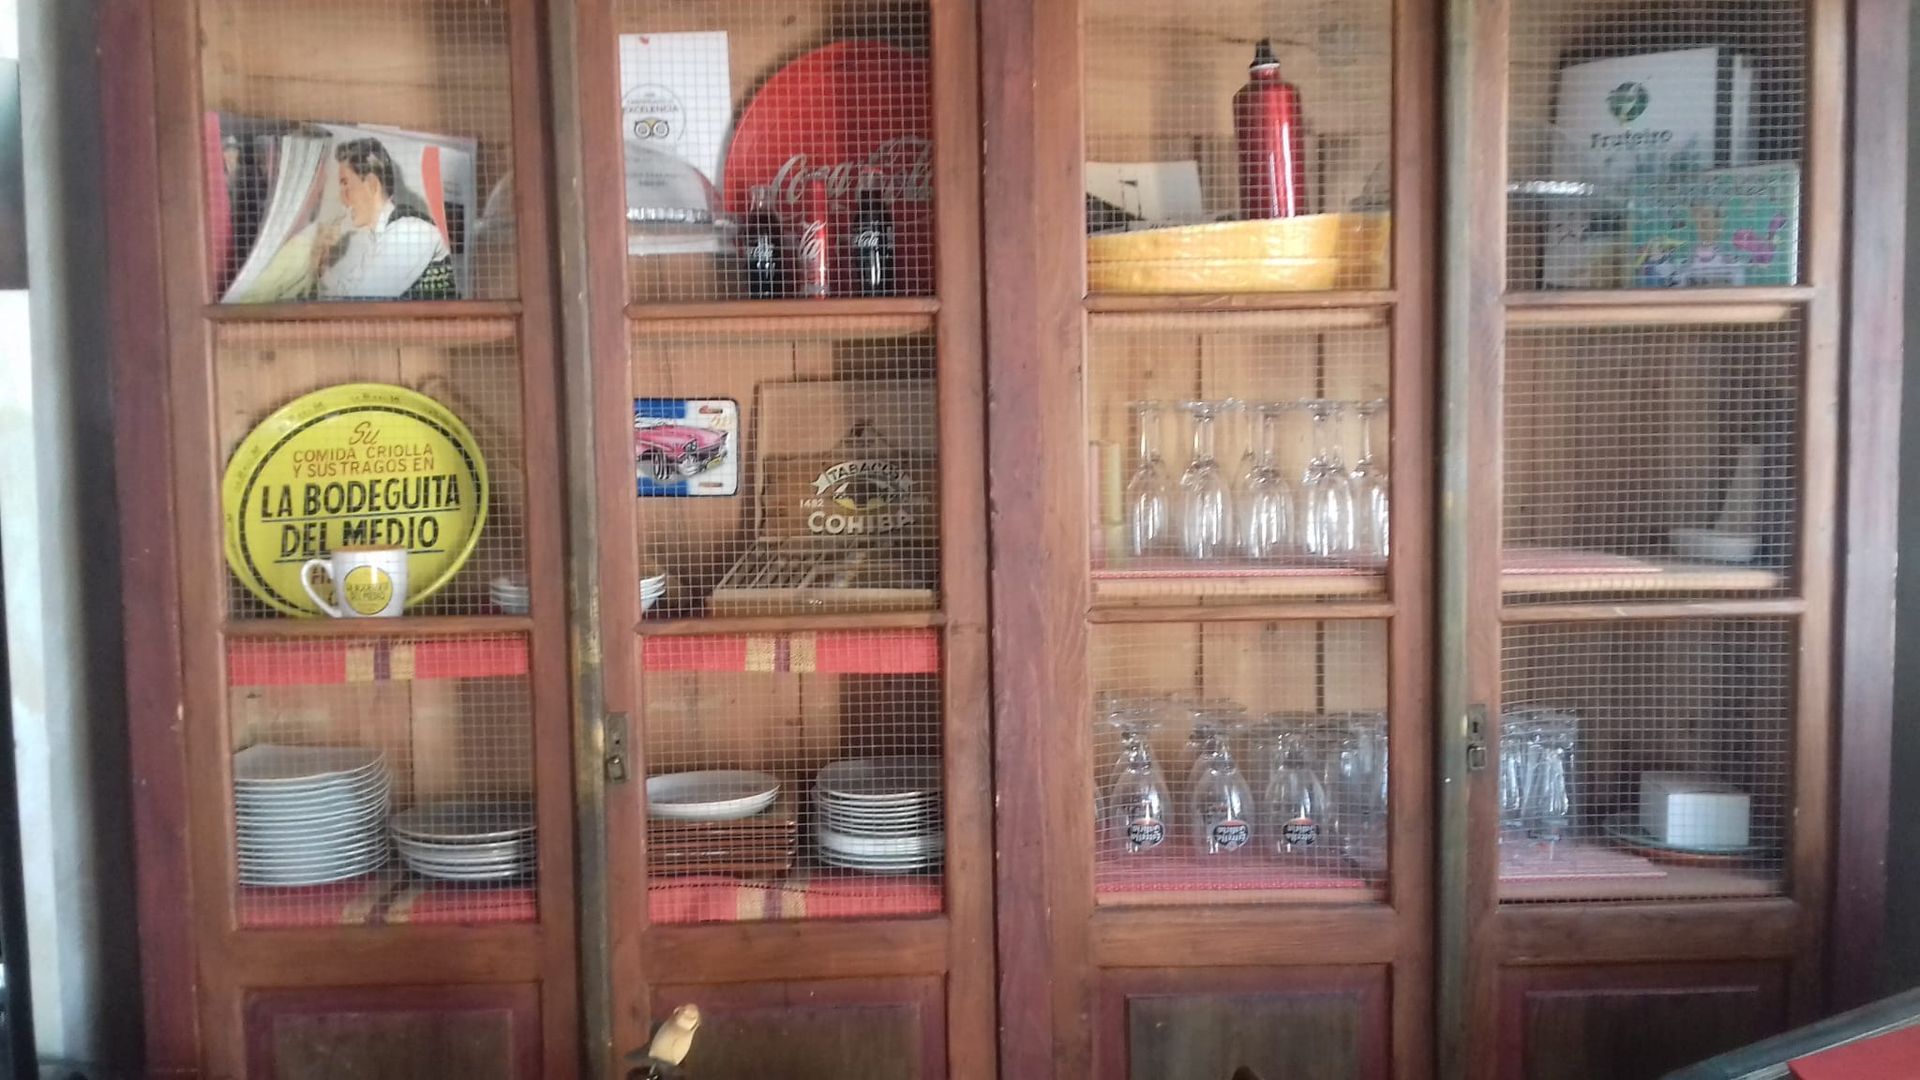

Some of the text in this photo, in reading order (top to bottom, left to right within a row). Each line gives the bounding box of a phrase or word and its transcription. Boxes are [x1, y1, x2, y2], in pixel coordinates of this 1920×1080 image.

[348, 420, 381, 446] Su
[292, 443, 434, 463] COMIDA CRIOLLA
[292, 456, 435, 478] Y SUS TRAGOS EN
[261, 474, 460, 518] LA BODEGUITA
[281, 515, 439, 557] DEL MEDIO
